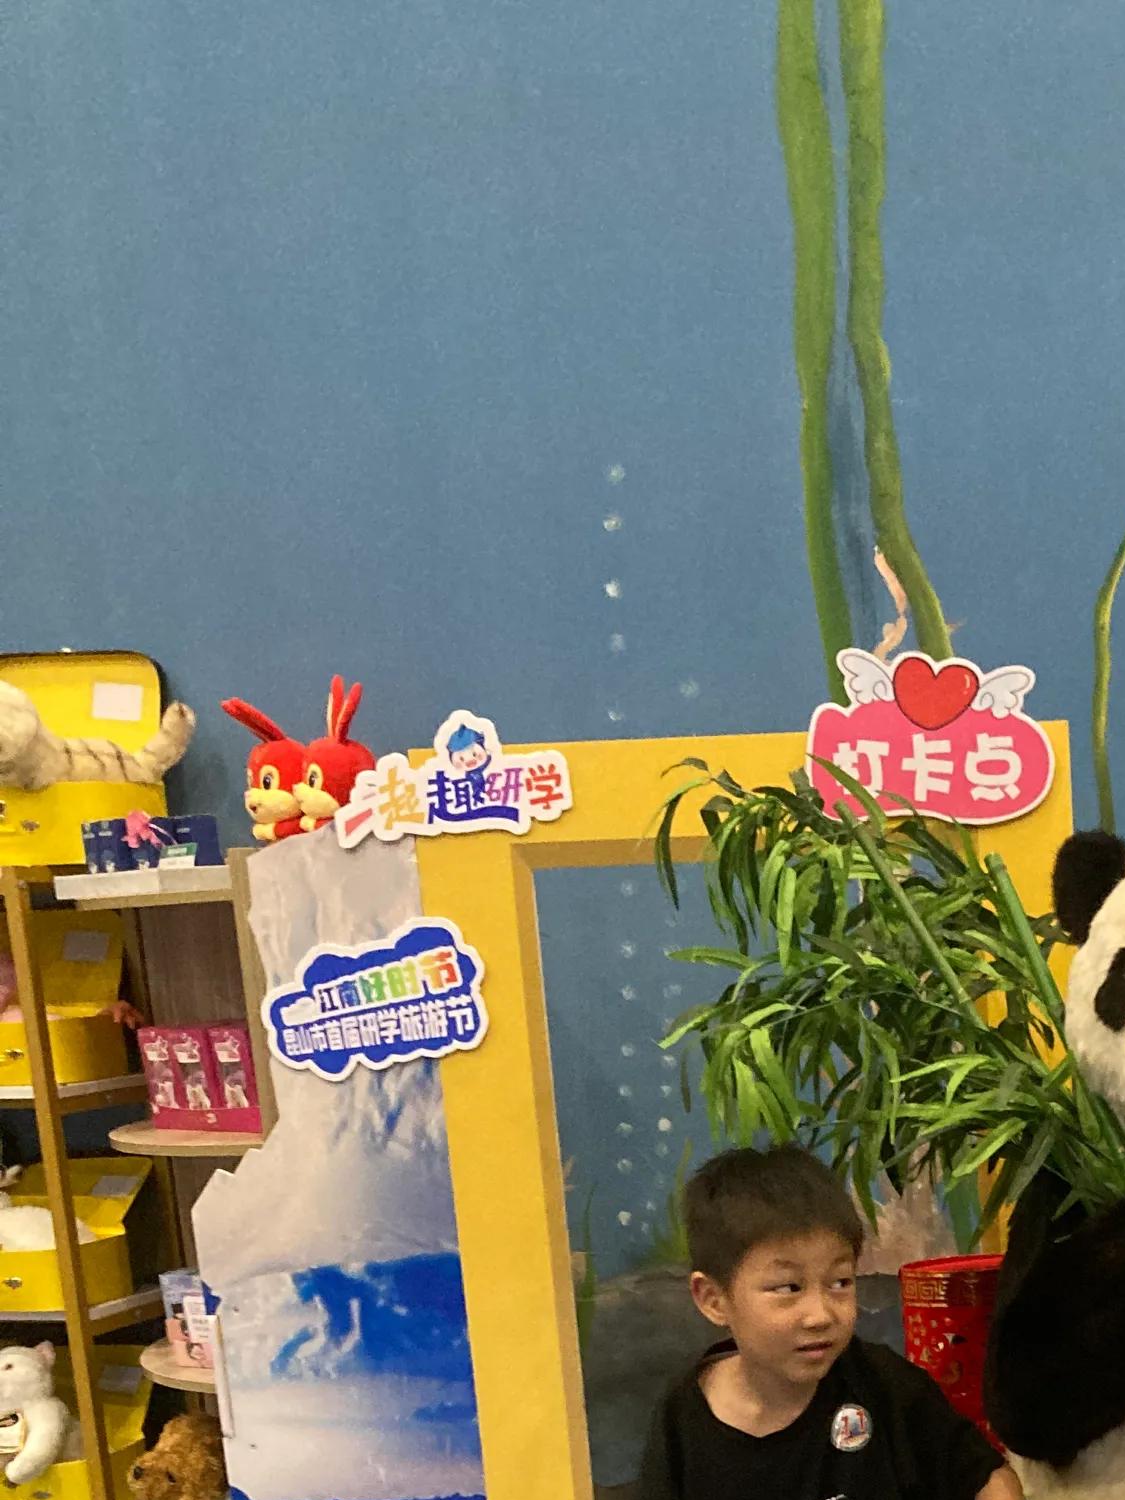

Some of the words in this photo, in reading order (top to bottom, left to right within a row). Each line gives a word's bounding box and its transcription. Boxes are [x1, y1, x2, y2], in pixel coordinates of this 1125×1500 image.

[832, 733, 1022, 802] 打卡点
[318, 951, 459, 1013] 江南好时节
[283, 994, 474, 1056] 昆山市首届研学旅游节
